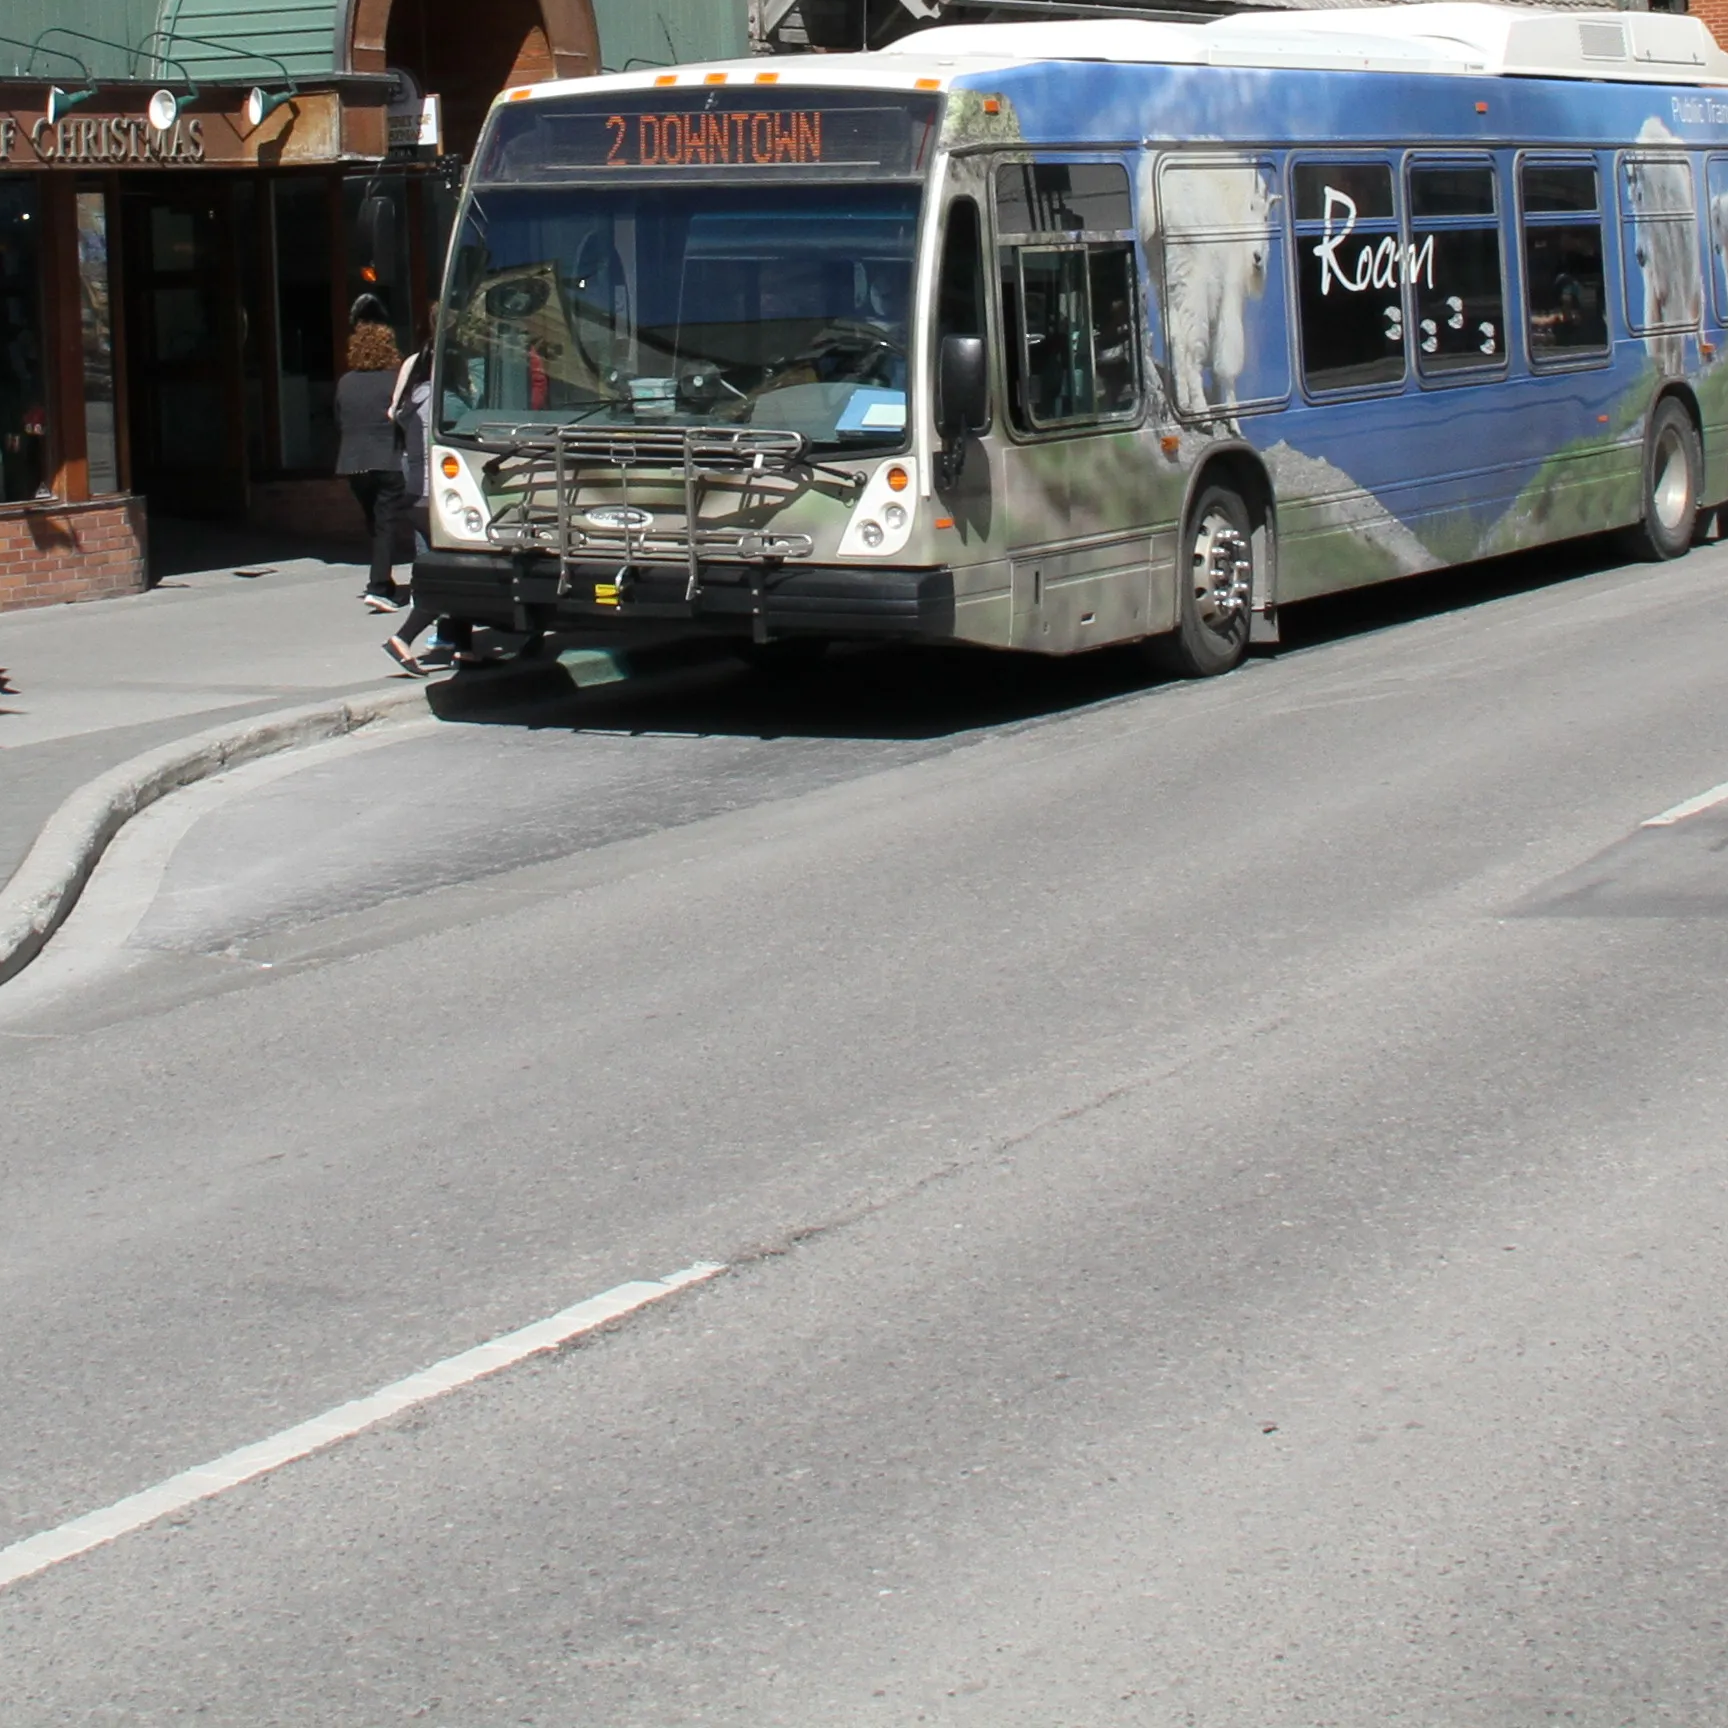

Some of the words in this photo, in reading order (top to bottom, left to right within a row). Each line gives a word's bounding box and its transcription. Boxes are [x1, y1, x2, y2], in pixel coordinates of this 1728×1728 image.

[1671, 96, 1704, 124] Public
[31, 117, 205, 165] CHRISTMAS
[606, 115, 626, 165] 2
[640, 111, 820, 165] DOWNTOWN
[1313, 185, 1433, 295] Roam
